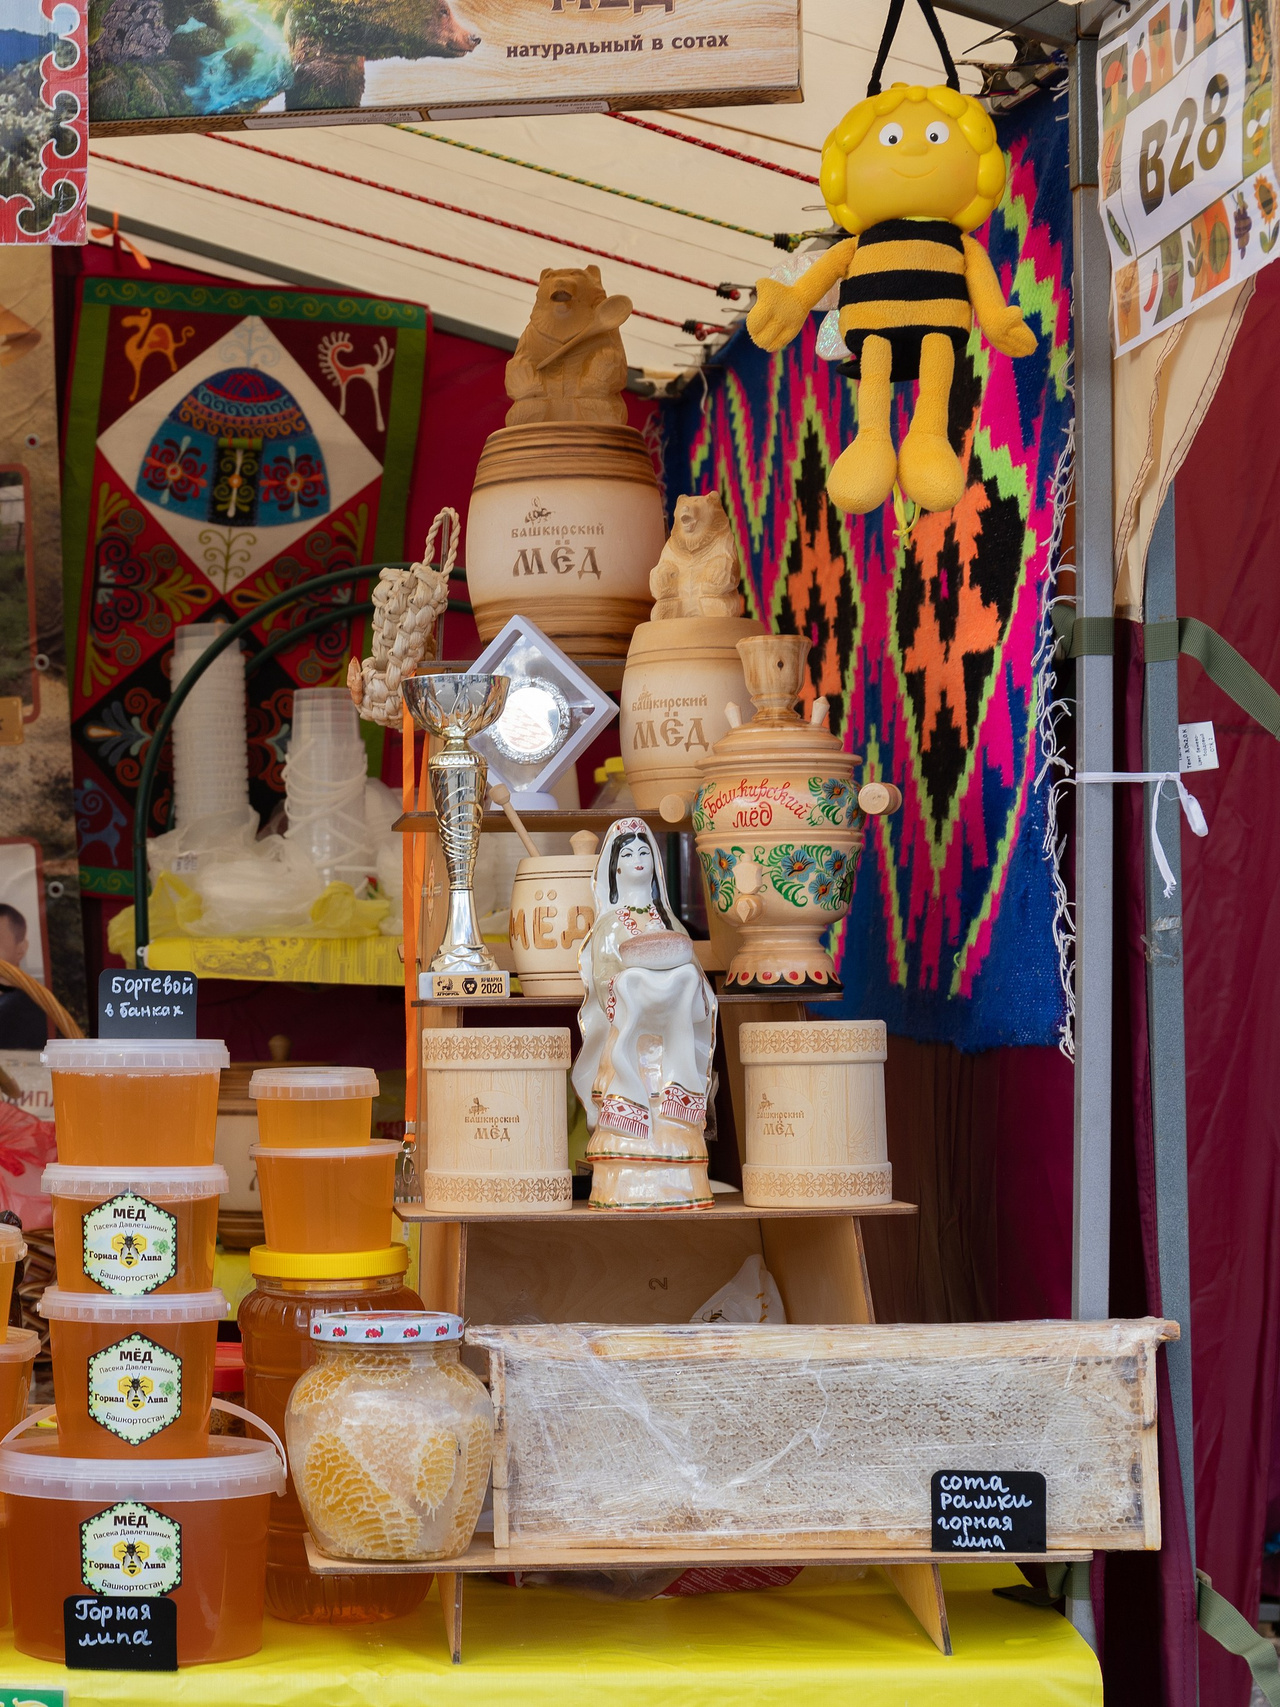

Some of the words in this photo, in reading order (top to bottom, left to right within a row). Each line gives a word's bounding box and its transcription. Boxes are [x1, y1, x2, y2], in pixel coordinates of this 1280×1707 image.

[506, 35, 643, 60] натуральный
[651, 40, 664, 50] в
[671, 33, 729, 50] сотах
[1139, 72, 1230, 216] B28
[513, 540, 602, 580] МЁД
[633, 711, 709, 752] МЁД
[703, 778, 812, 819] Башкирский
[732, 801, 772, 828] мёд
[111, 975, 193, 1000] Бортевой
[481, 983, 503, 994] 2020
[104, 1002, 114, 1017] в
[119, 1002, 184, 1018] банках
[474, 1125, 510, 1142] МЁД
[763, 1120, 795, 1137] МЁД
[113, 1205, 147, 1221] МЁД
[93, 1222, 117, 1232] Пасека
[119, 1221, 168, 1233] Давлетшиных
[88, 1250, 118, 1261] Горная
[99, 1269, 159, 1283] Башкортостан
[119, 1348, 153, 1363] МЁД
[99, 1364, 124, 1374] Пасека
[125, 1364, 174, 1374] Давлетшиных
[94, 1393, 124, 1403] Горная
[105, 1412, 165, 1425] Башкортостан
[113, 1512, 148, 1528] МЁД
[937, 1515, 1013, 1537] горная
[93, 1530, 118, 1540] Пасека
[120, 1529, 172, 1540] Давлетшиных
[952, 1534, 1006, 1551] липа
[88, 1560, 120, 1570] Горная
[143, 1561, 166, 1570] Липа
[101, 1579, 163, 1592] Башкортостан
[75, 1599, 151, 1627] Горная
[78, 1628, 153, 1647] липа
